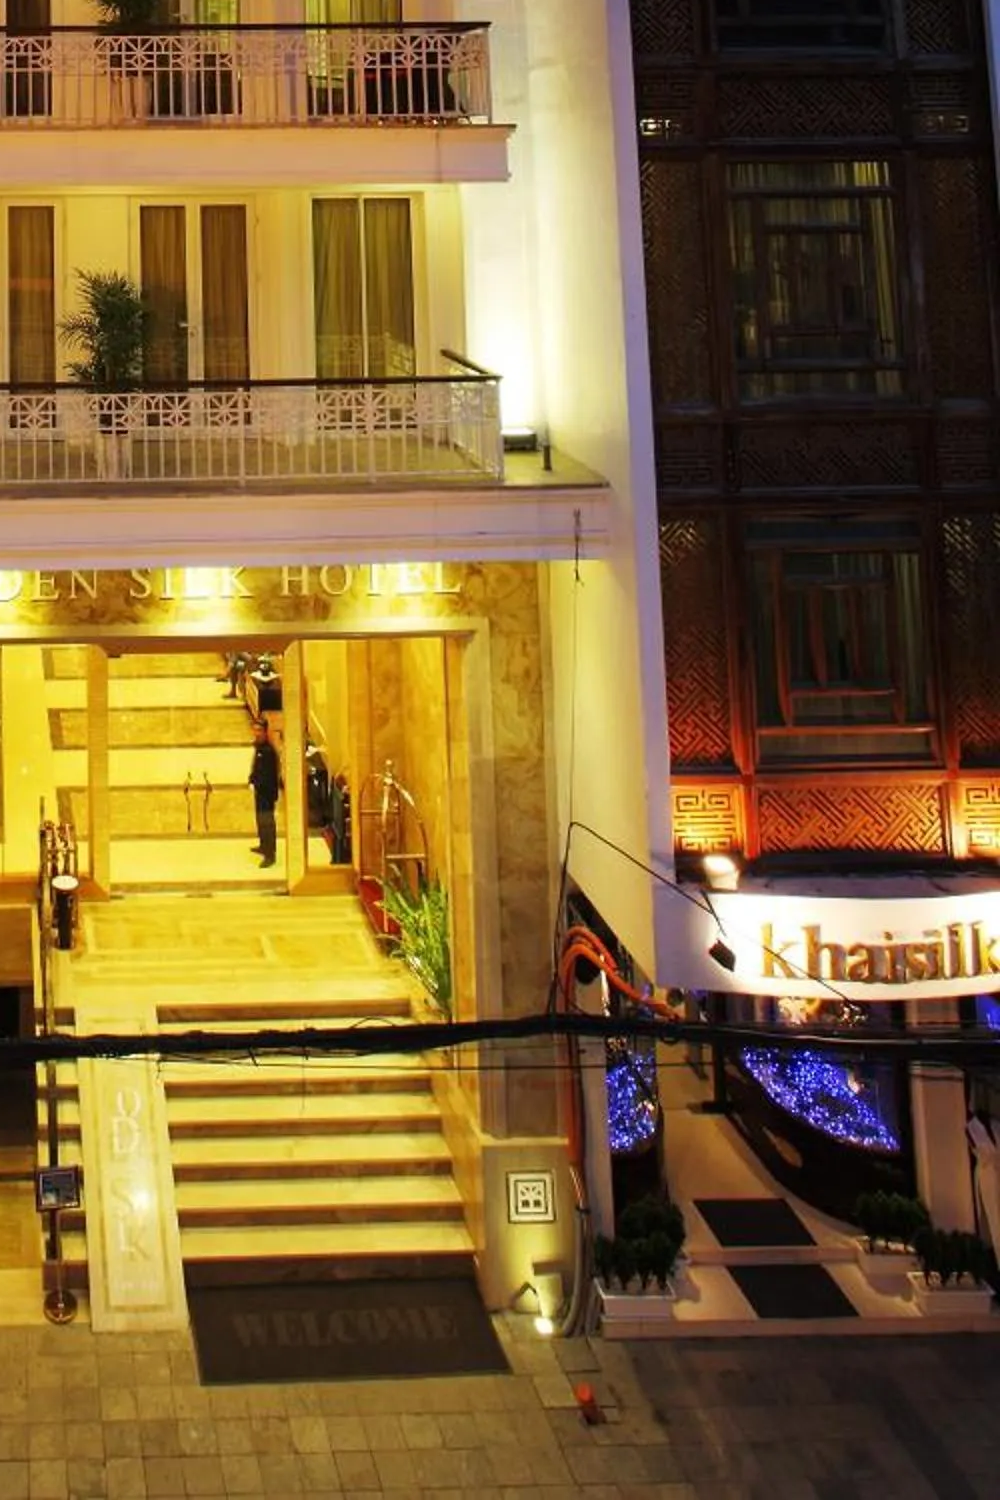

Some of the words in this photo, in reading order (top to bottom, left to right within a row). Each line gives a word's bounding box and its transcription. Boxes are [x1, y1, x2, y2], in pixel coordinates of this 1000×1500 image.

[129, 566, 254, 599] SILK
[280, 561, 462, 597] HOTEL
[760, 920, 1000, 984] khaisilk
[232, 1307, 458, 1347] WELCOME
